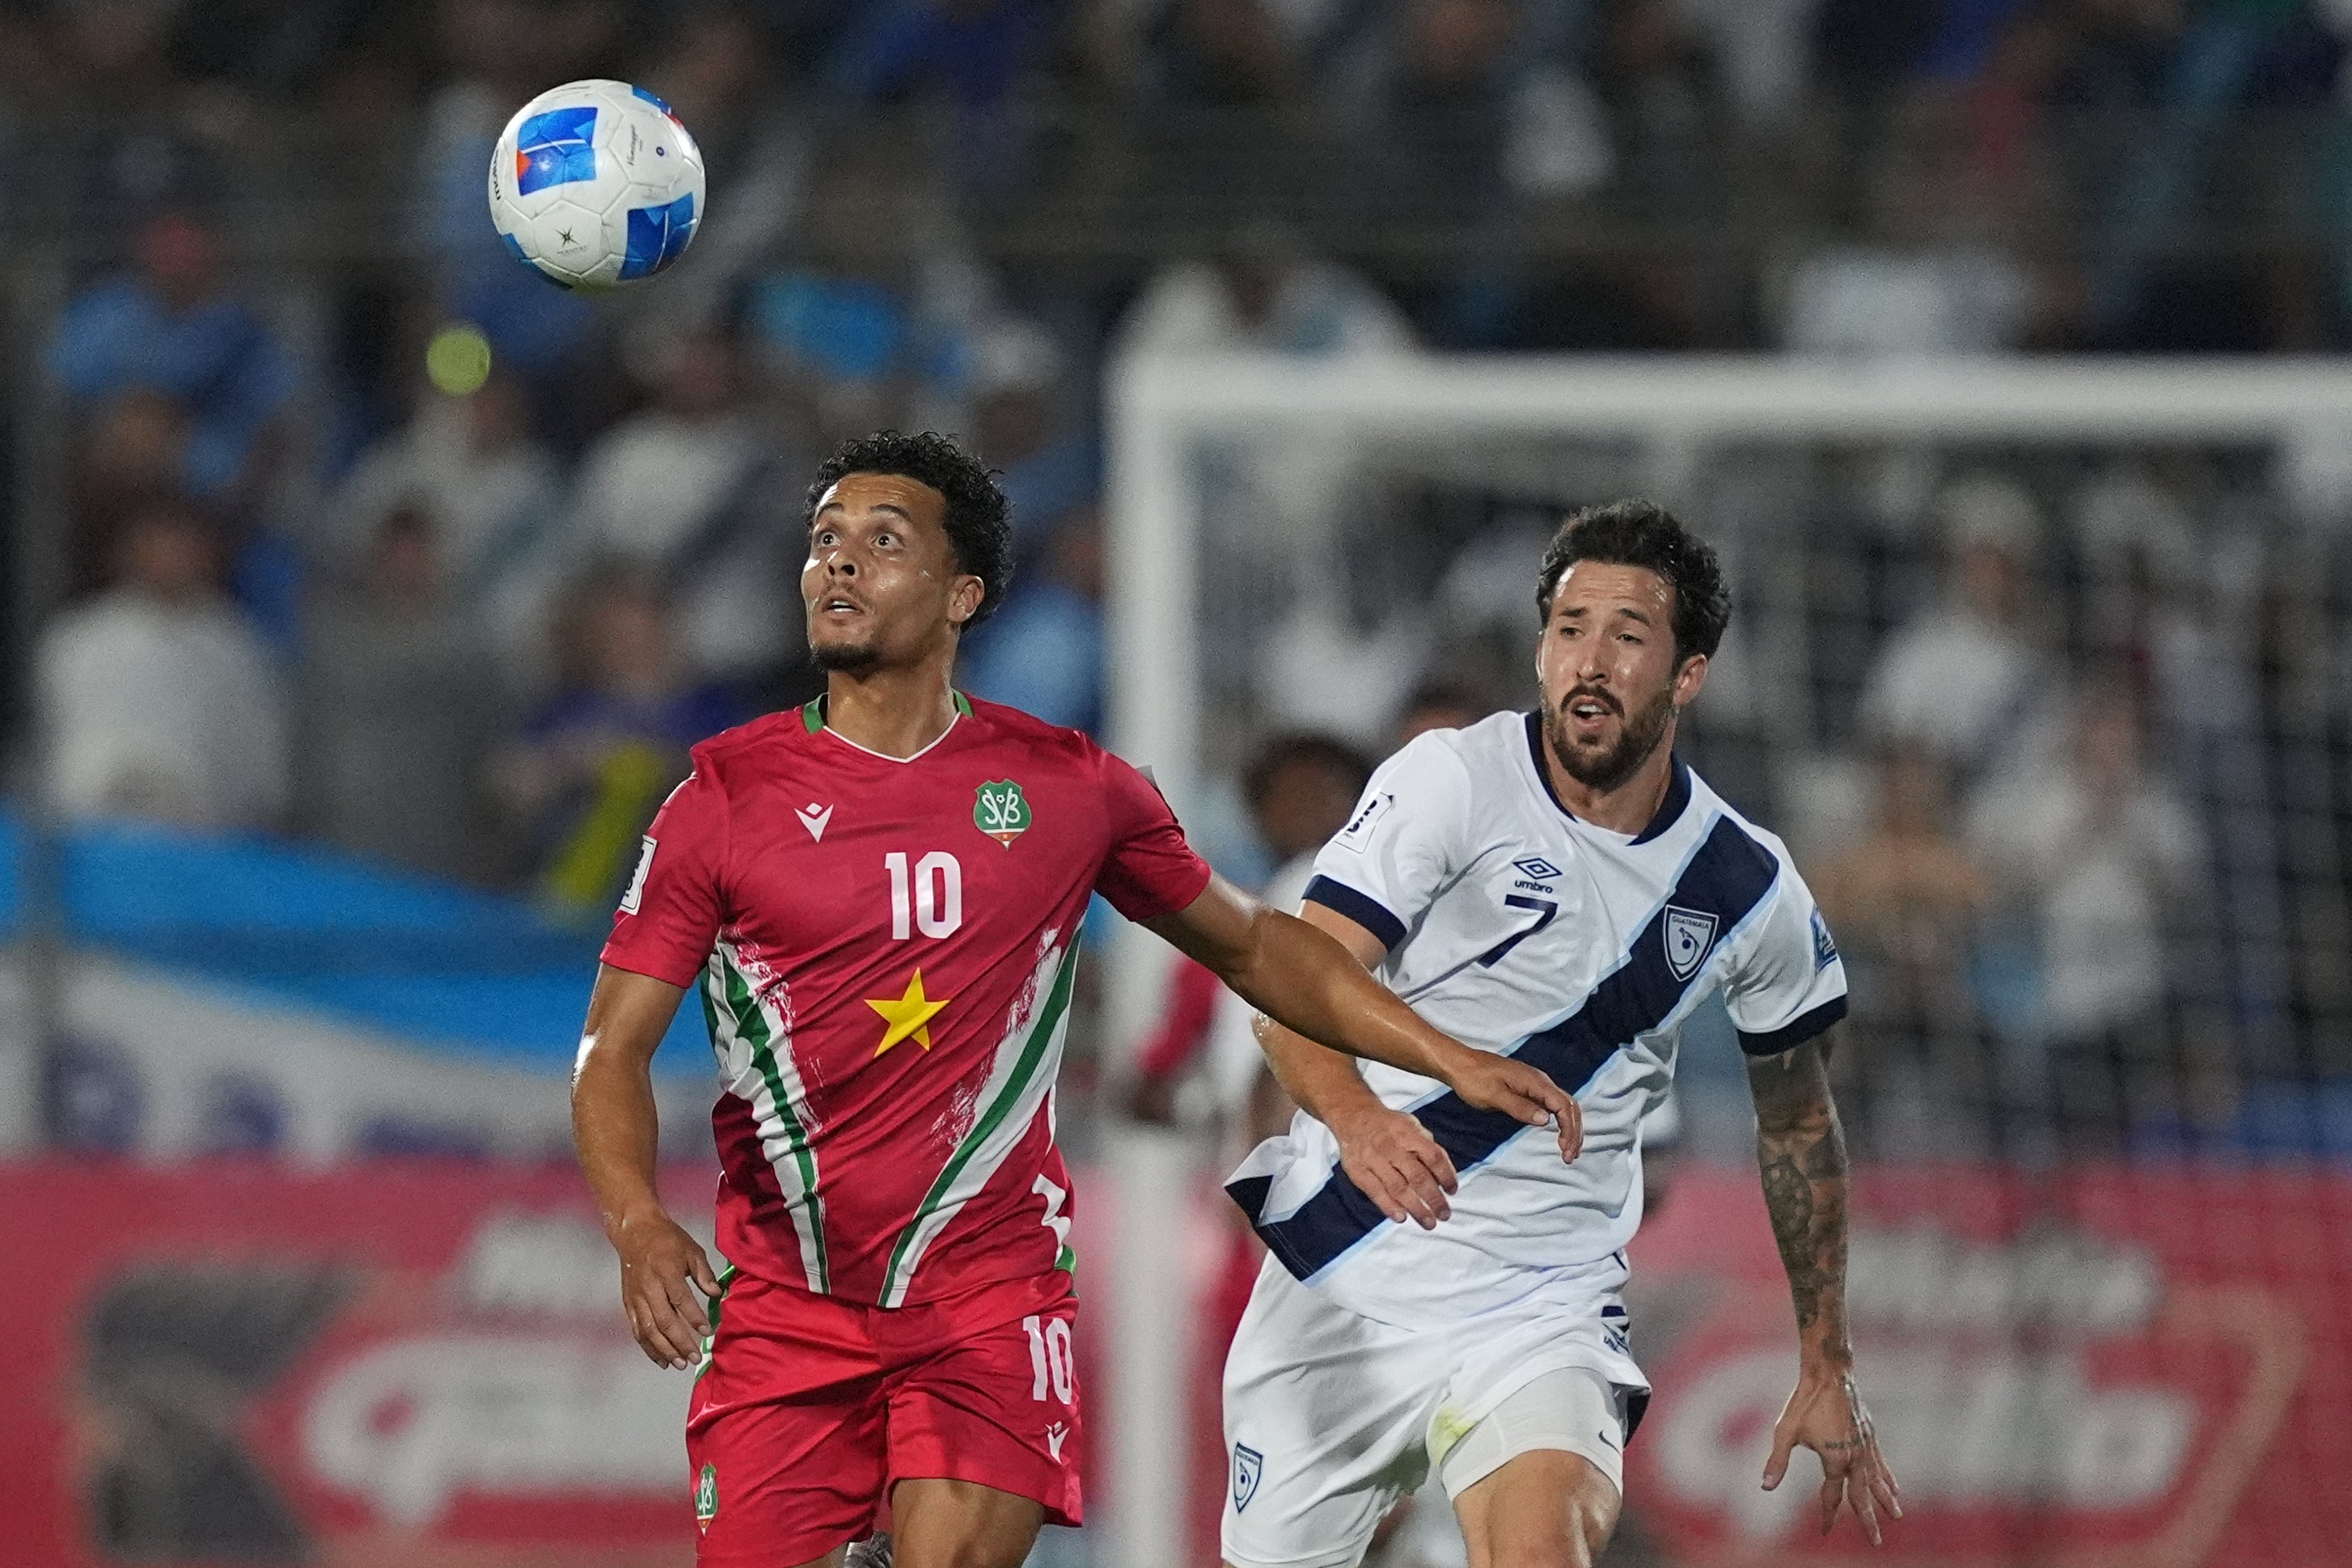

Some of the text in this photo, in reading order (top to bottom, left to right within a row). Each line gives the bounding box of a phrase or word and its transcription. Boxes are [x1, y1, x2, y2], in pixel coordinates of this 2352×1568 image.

[884, 851, 962, 940] 10
[1514, 879, 1554, 894] umbro
[1476, 894, 1559, 970] 7
[1022, 1315, 1073, 1405] 10
